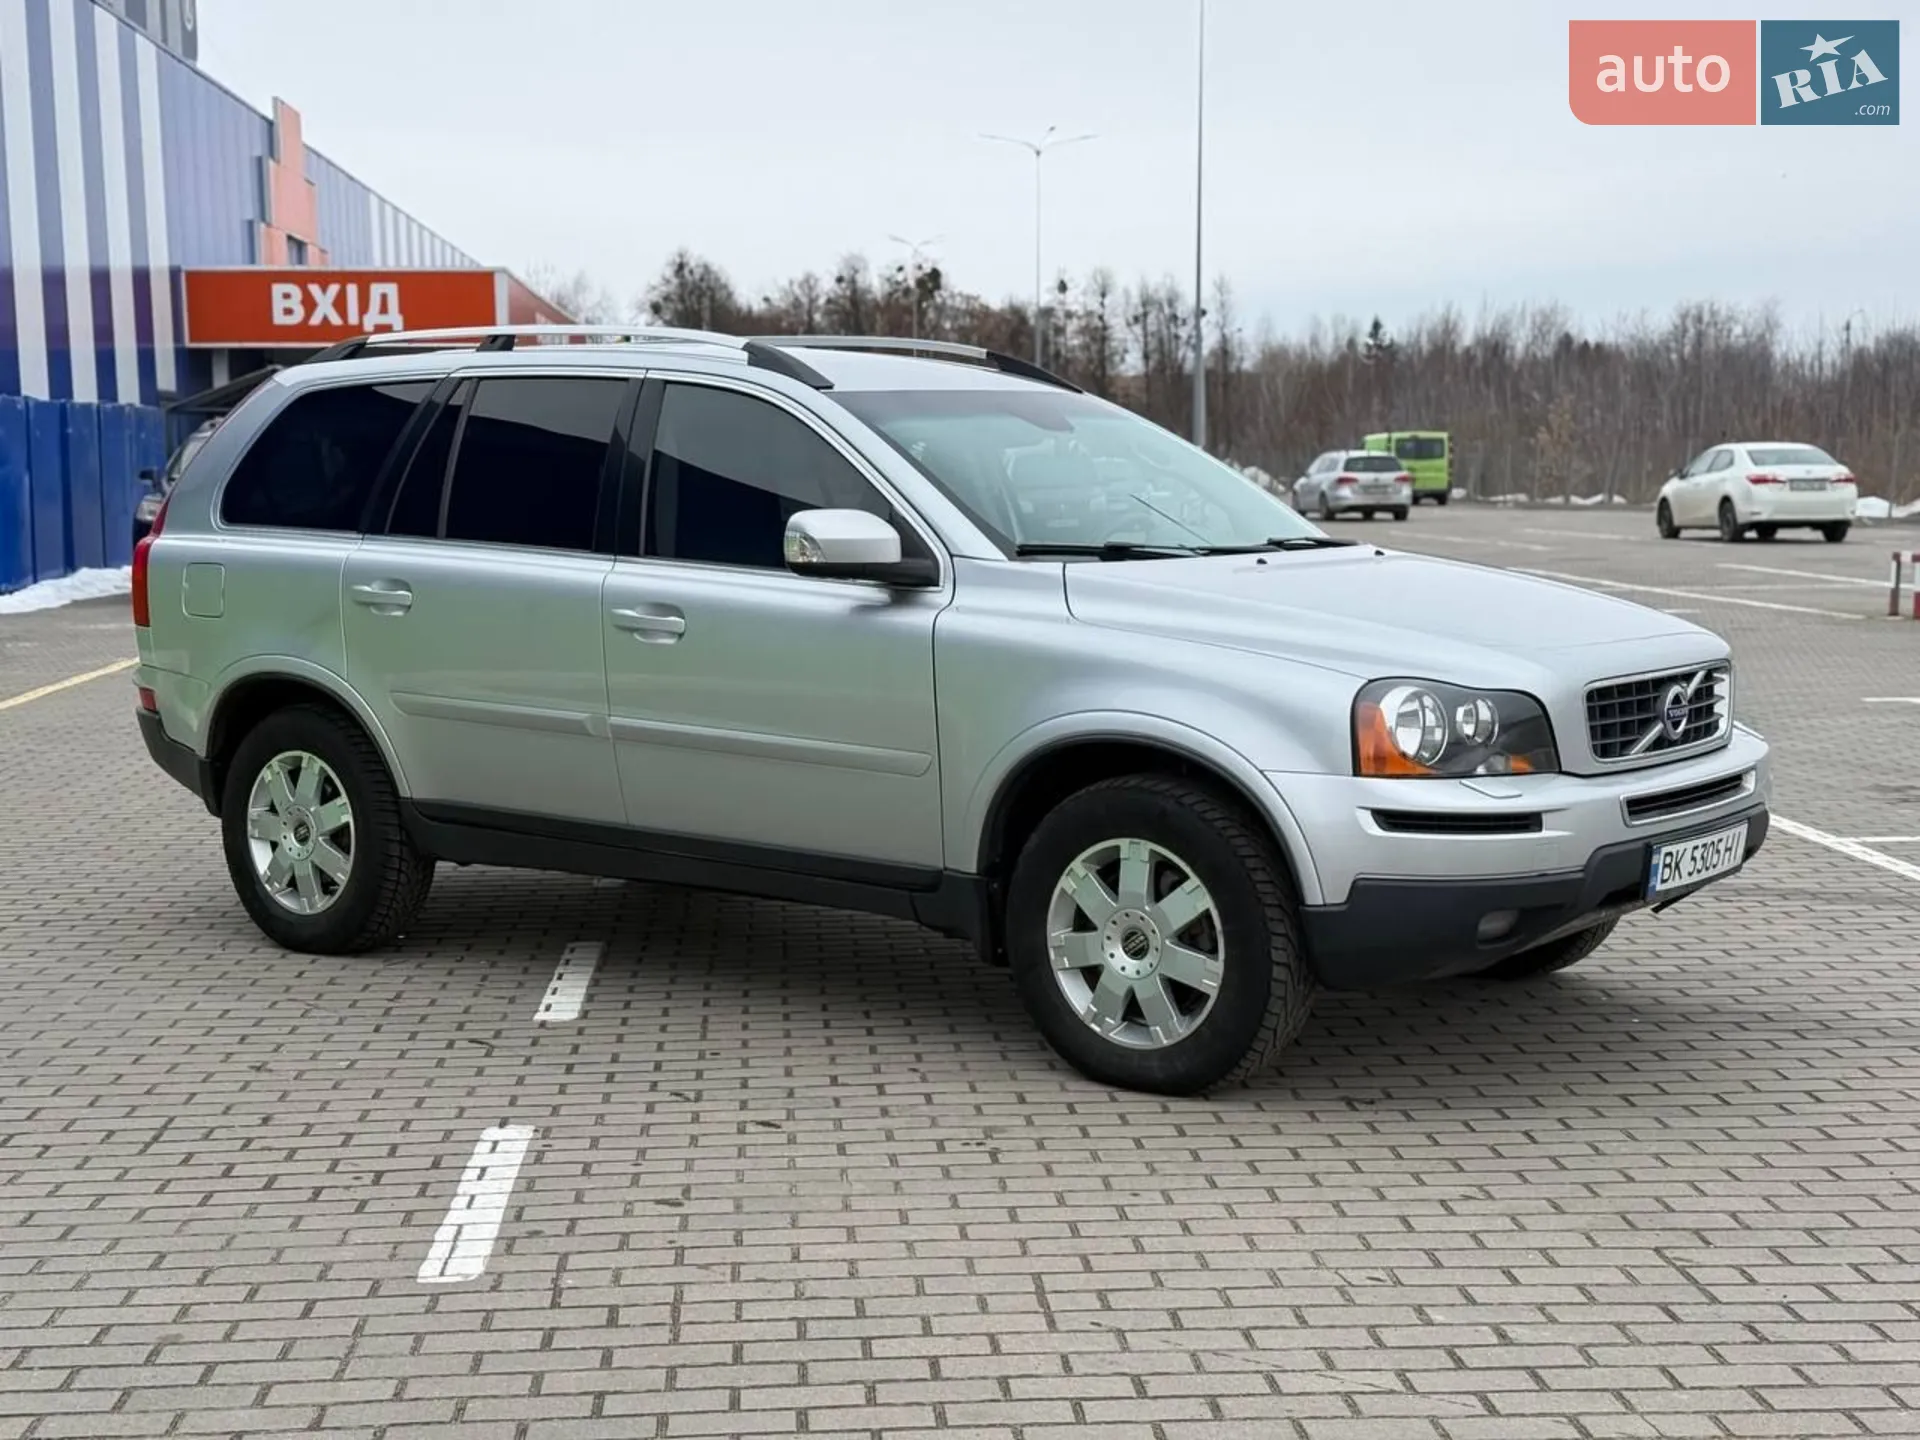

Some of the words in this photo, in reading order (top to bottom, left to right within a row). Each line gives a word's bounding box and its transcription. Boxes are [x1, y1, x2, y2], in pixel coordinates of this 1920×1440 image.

[271, 282, 404, 332] ВХІД
[1660, 847, 1687, 884] BK
[1687, 837, 1724, 877] 5305
